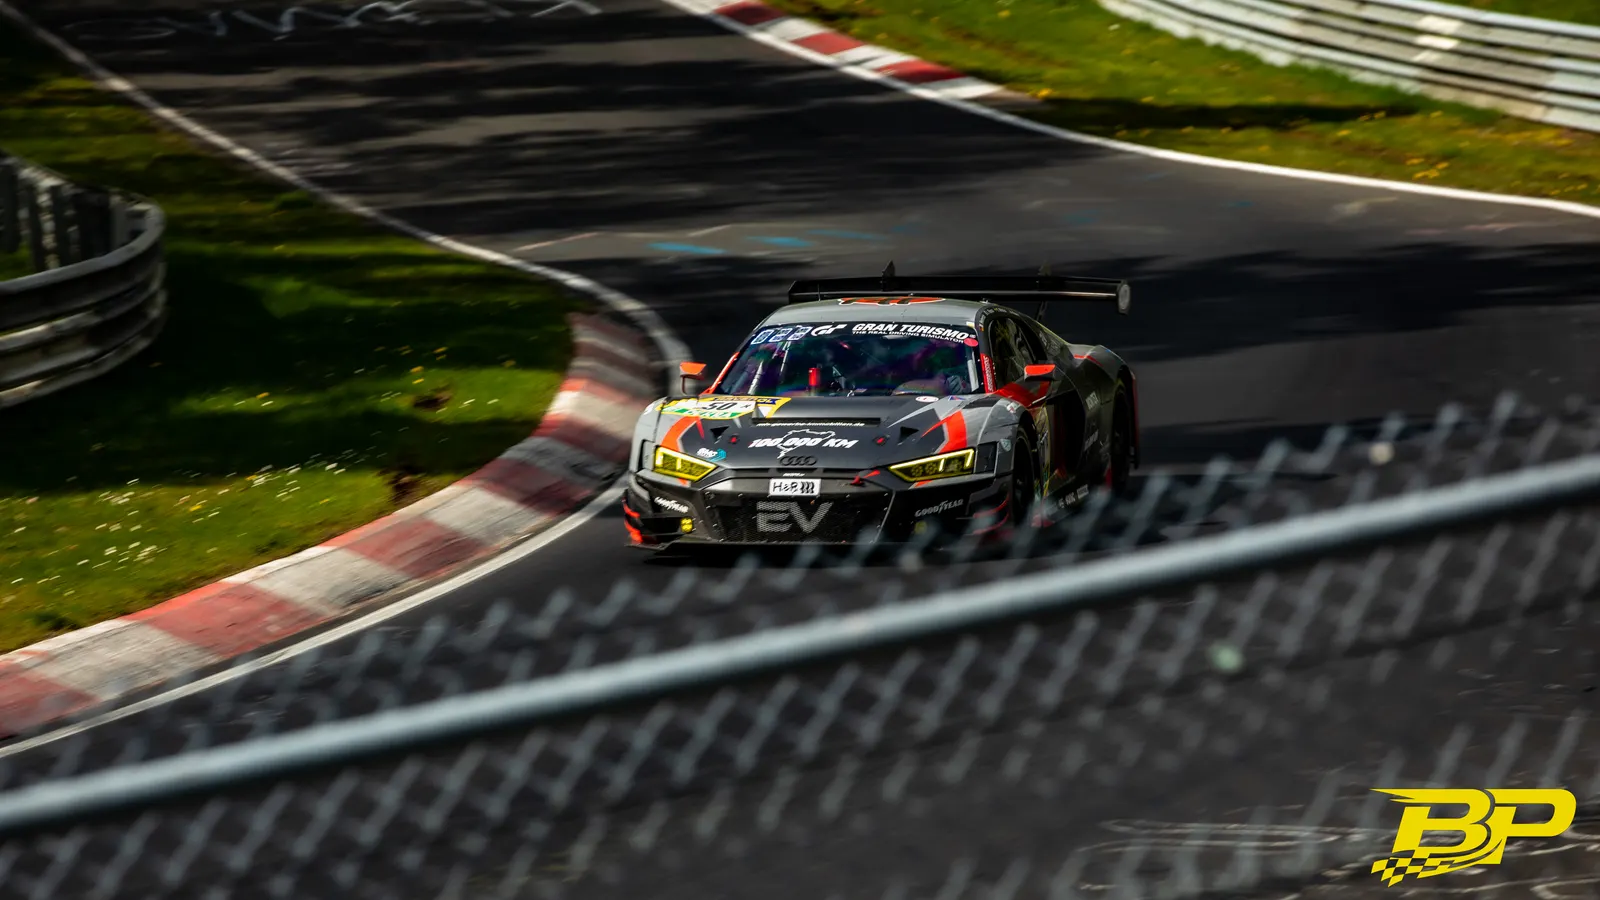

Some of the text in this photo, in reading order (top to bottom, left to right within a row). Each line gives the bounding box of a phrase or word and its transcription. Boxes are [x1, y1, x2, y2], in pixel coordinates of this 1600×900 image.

[852, 323, 969, 340] GRAN TURISMO
[921, 333, 964, 343] SIMULATOR
[822, 438, 859, 449] KM
[914, 498, 964, 518] GOODYEAR
[757, 501, 834, 533] EV
